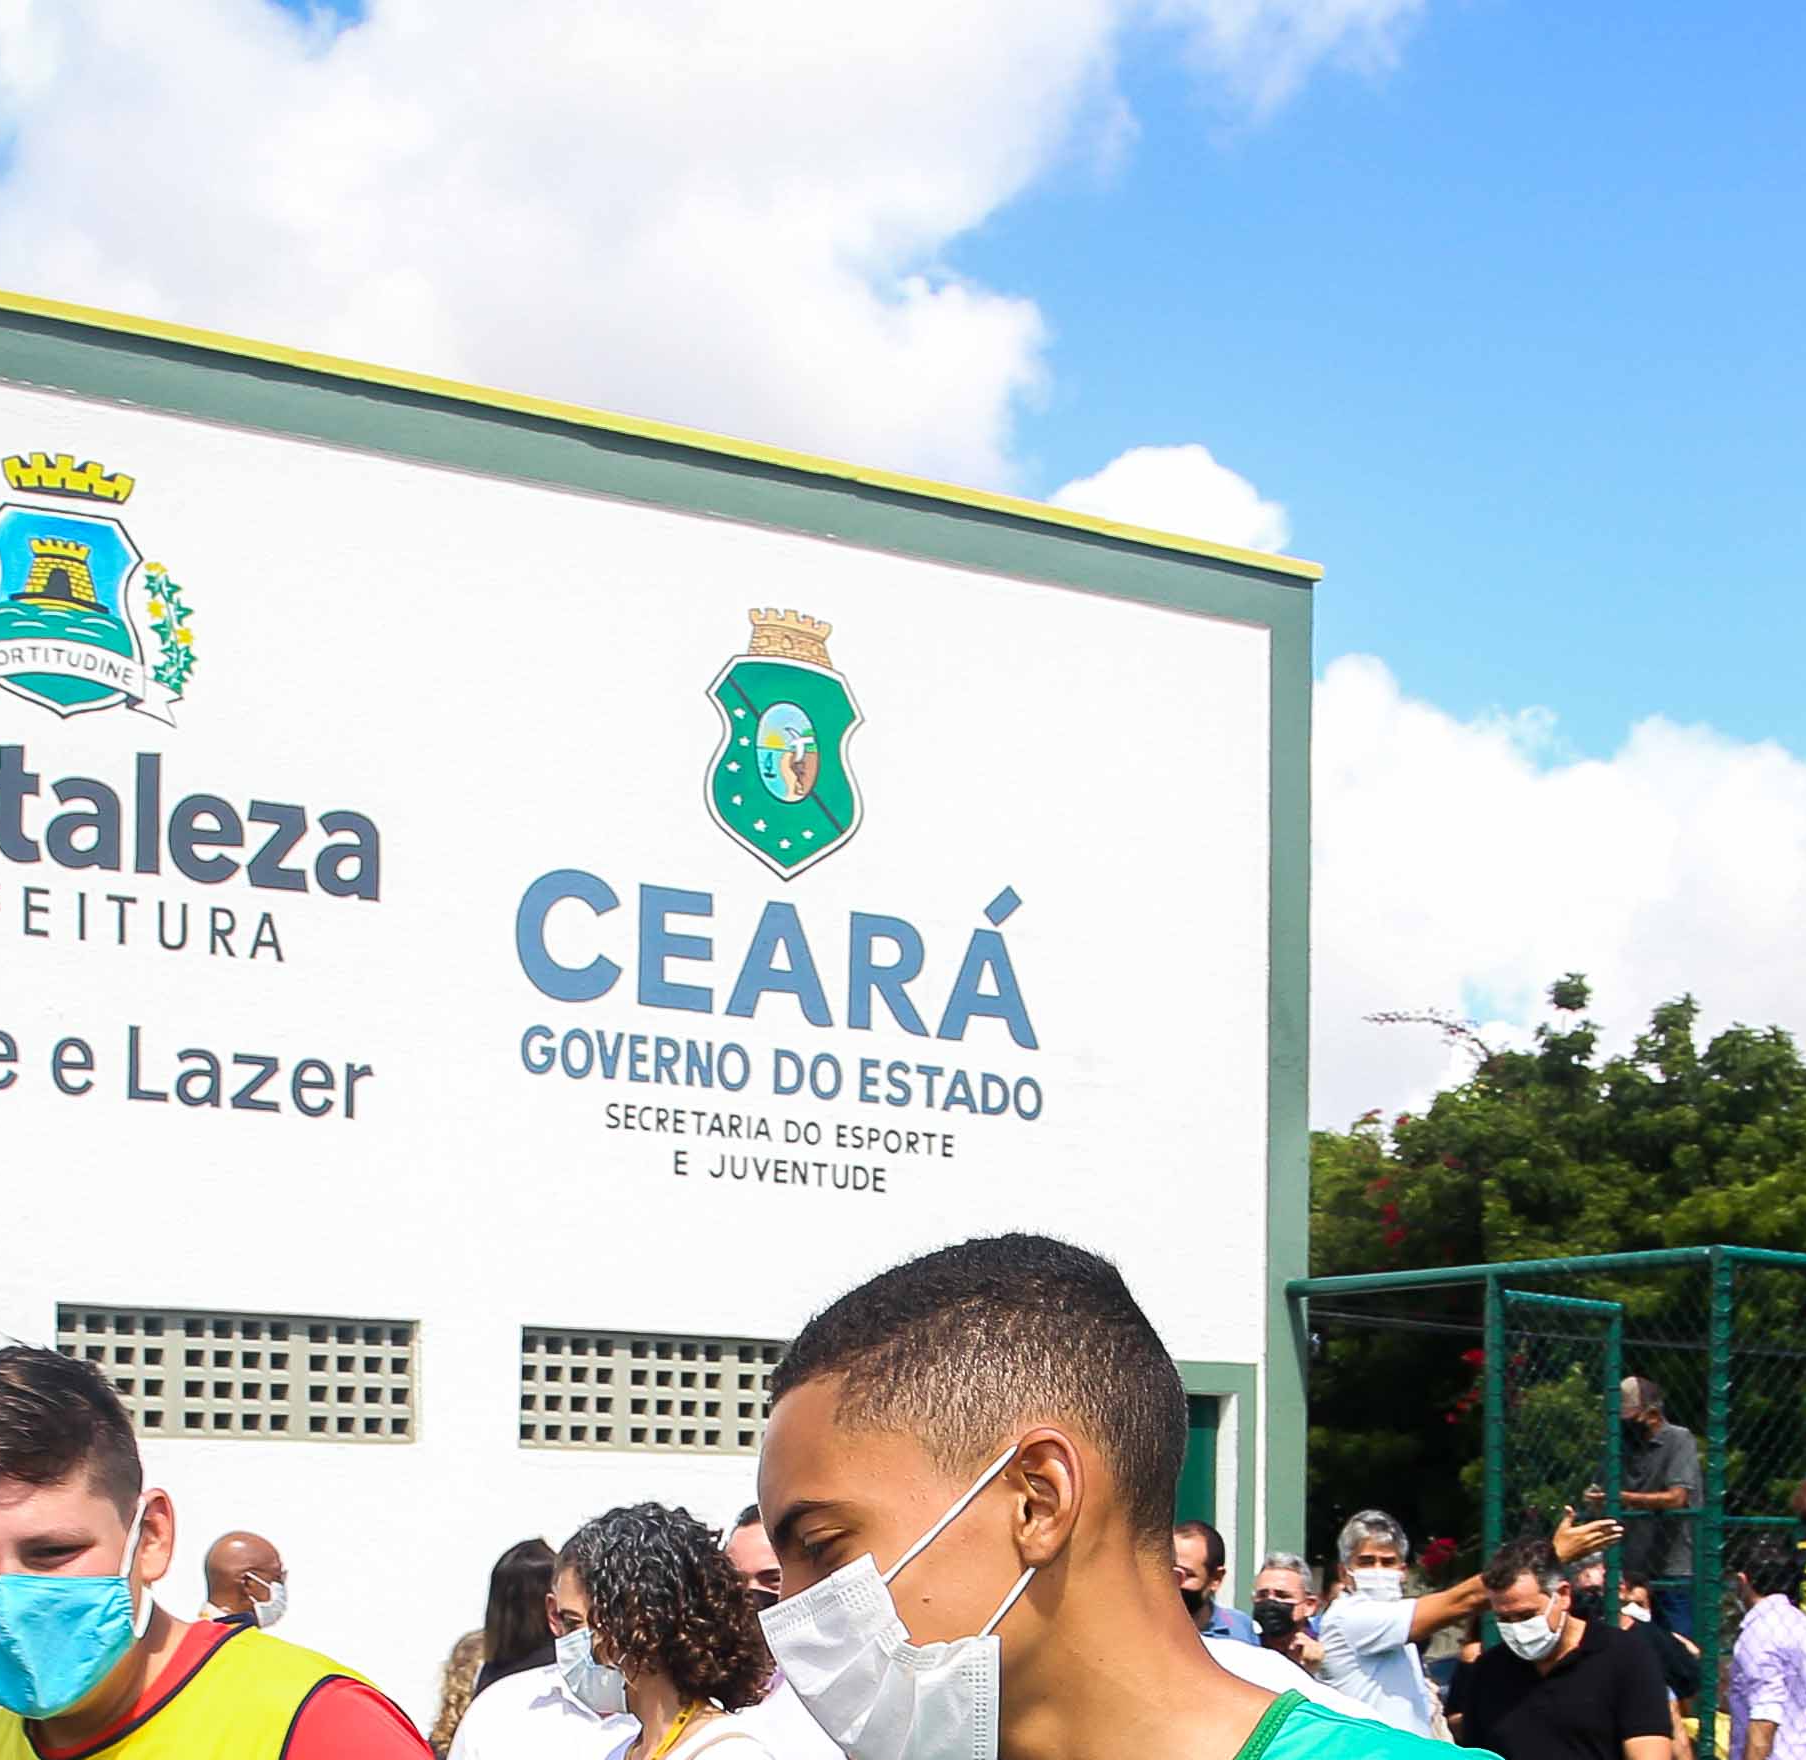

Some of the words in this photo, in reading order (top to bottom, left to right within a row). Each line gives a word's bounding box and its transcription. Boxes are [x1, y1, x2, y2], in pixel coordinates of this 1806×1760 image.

[515, 867, 1039, 1050] CEARÁ
[51, 1036, 95, 1096] e
[127, 1025, 375, 1119] Lazer
[521, 1024, 750, 1092] GOVERNO
[773, 1048, 843, 1101] DO
[859, 1057, 1043, 1121] ESTADO
[605, 1102, 771, 1140] SECRETARIA
[785, 1119, 822, 1147] DO
[836, 1124, 956, 1159] ESPORTE
[674, 1150, 688, 1176] E
[709, 1154, 887, 1194] JUVENTUDE
